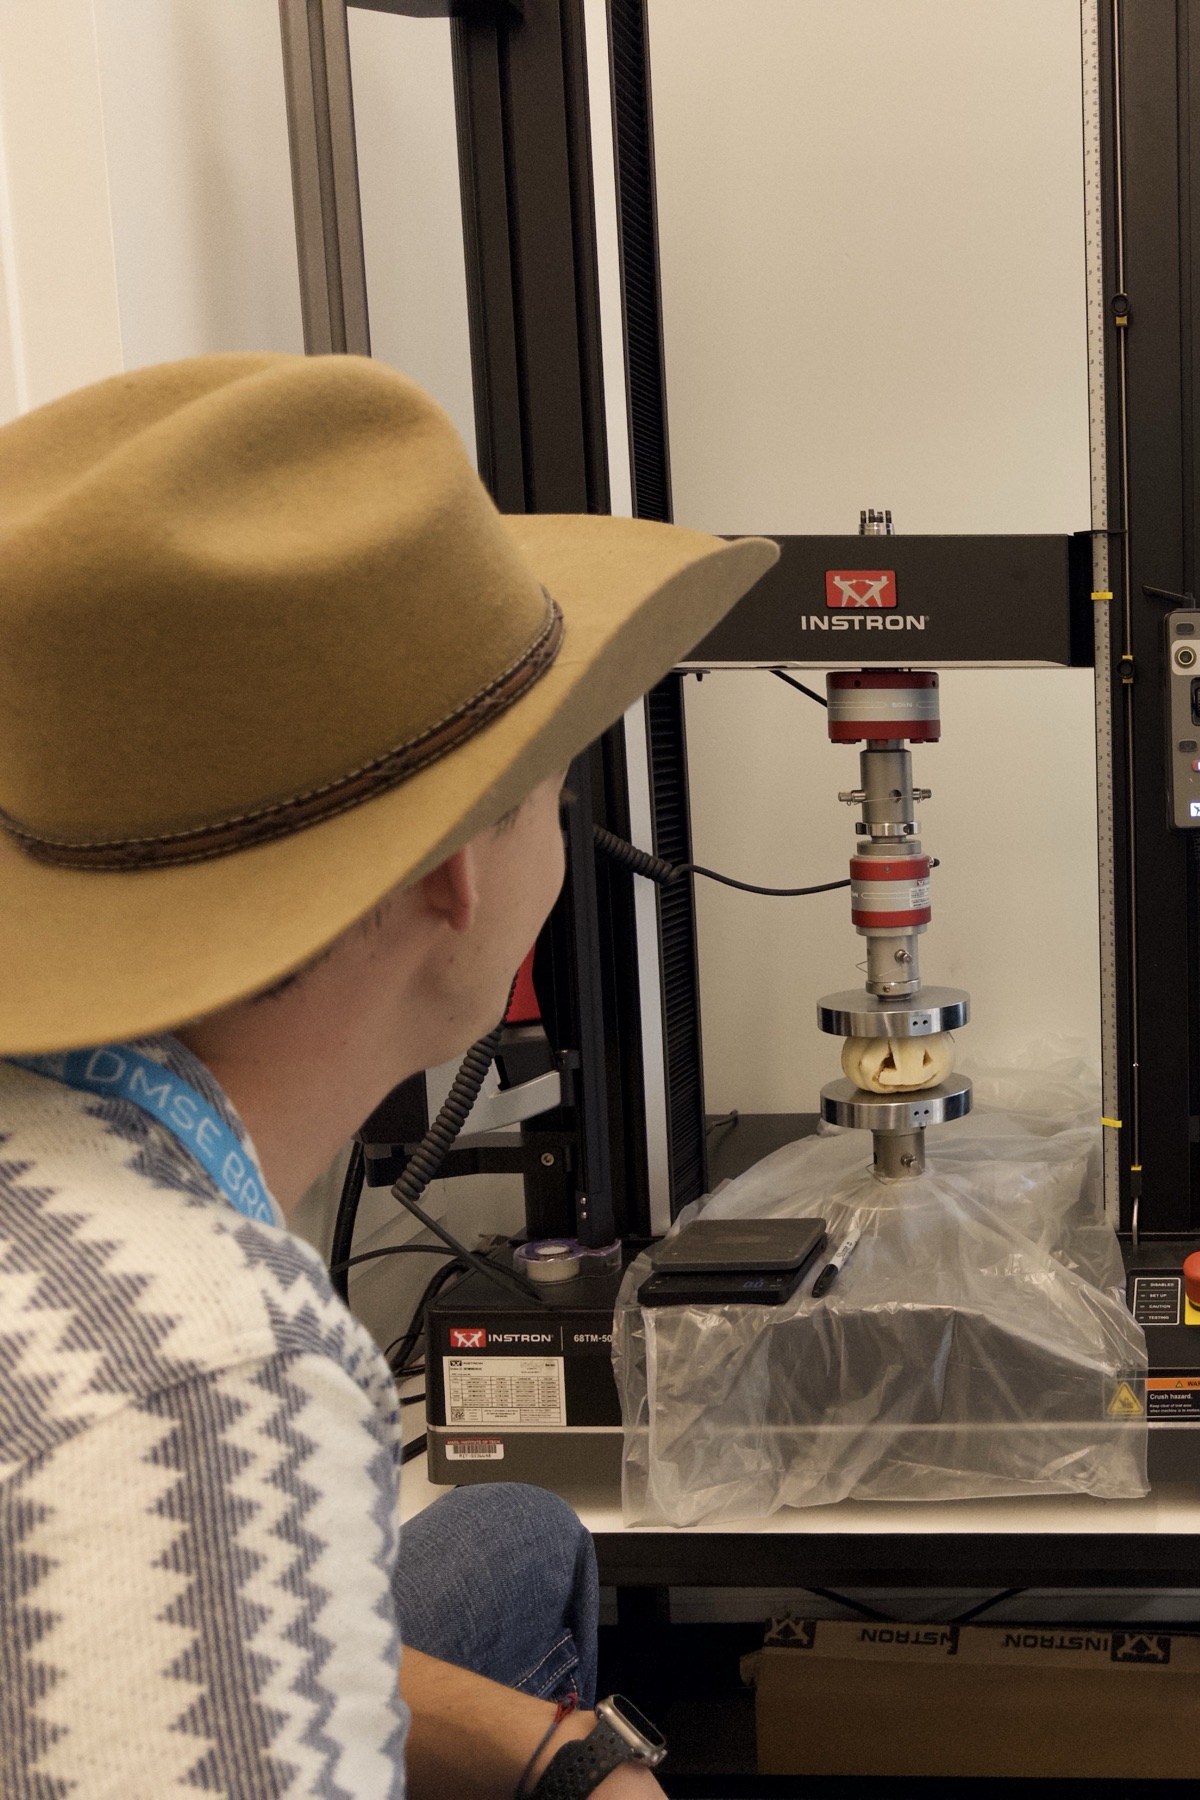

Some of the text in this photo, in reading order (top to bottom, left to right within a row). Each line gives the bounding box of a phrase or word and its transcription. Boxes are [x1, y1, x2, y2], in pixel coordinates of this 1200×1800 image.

[801, 615, 926, 631] INSTRON
[84, 1049, 222, 1158] DMSE
[488, 1334, 551, 1342] INSTRON
[1005, 1635, 1109, 1652] INSTRON
